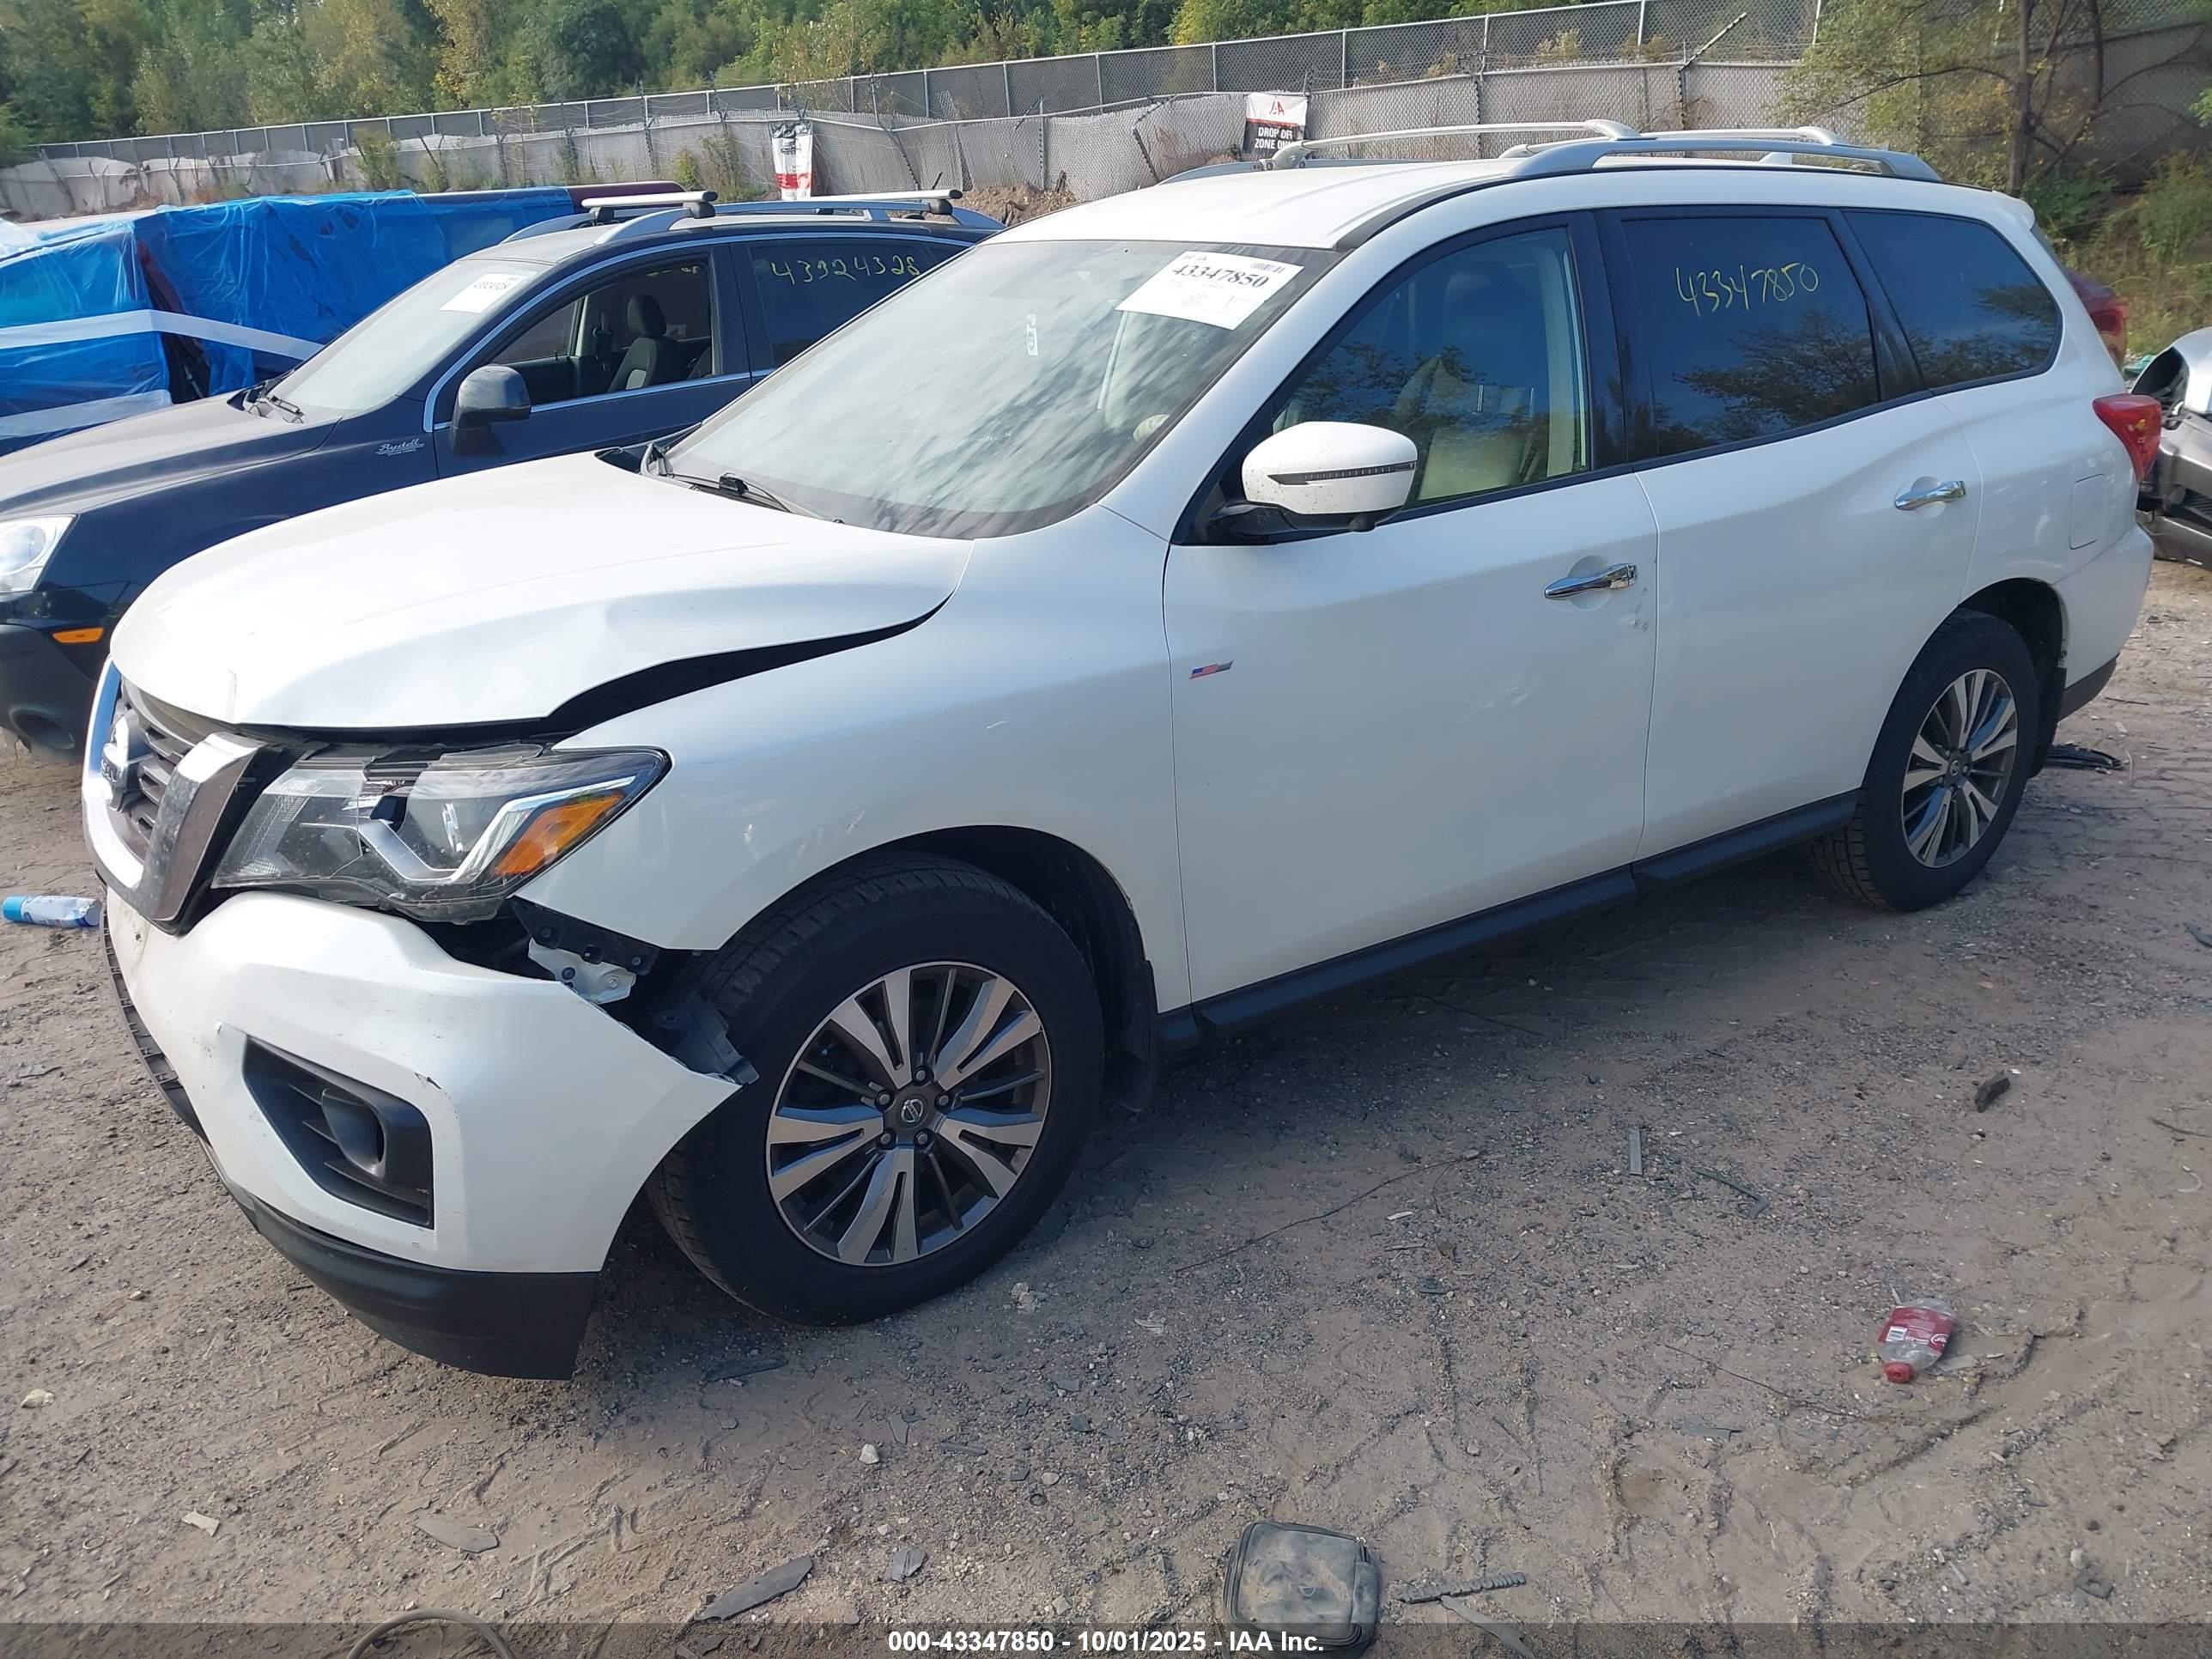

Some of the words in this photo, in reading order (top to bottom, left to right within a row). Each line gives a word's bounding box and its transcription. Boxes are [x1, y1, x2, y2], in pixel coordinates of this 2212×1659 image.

[1258, 126, 1279, 137] DROP
[1255, 138, 1276, 149] ZONE
[1172, 264, 1269, 288] 43347850
[1675, 262, 1819, 318] 43347850
